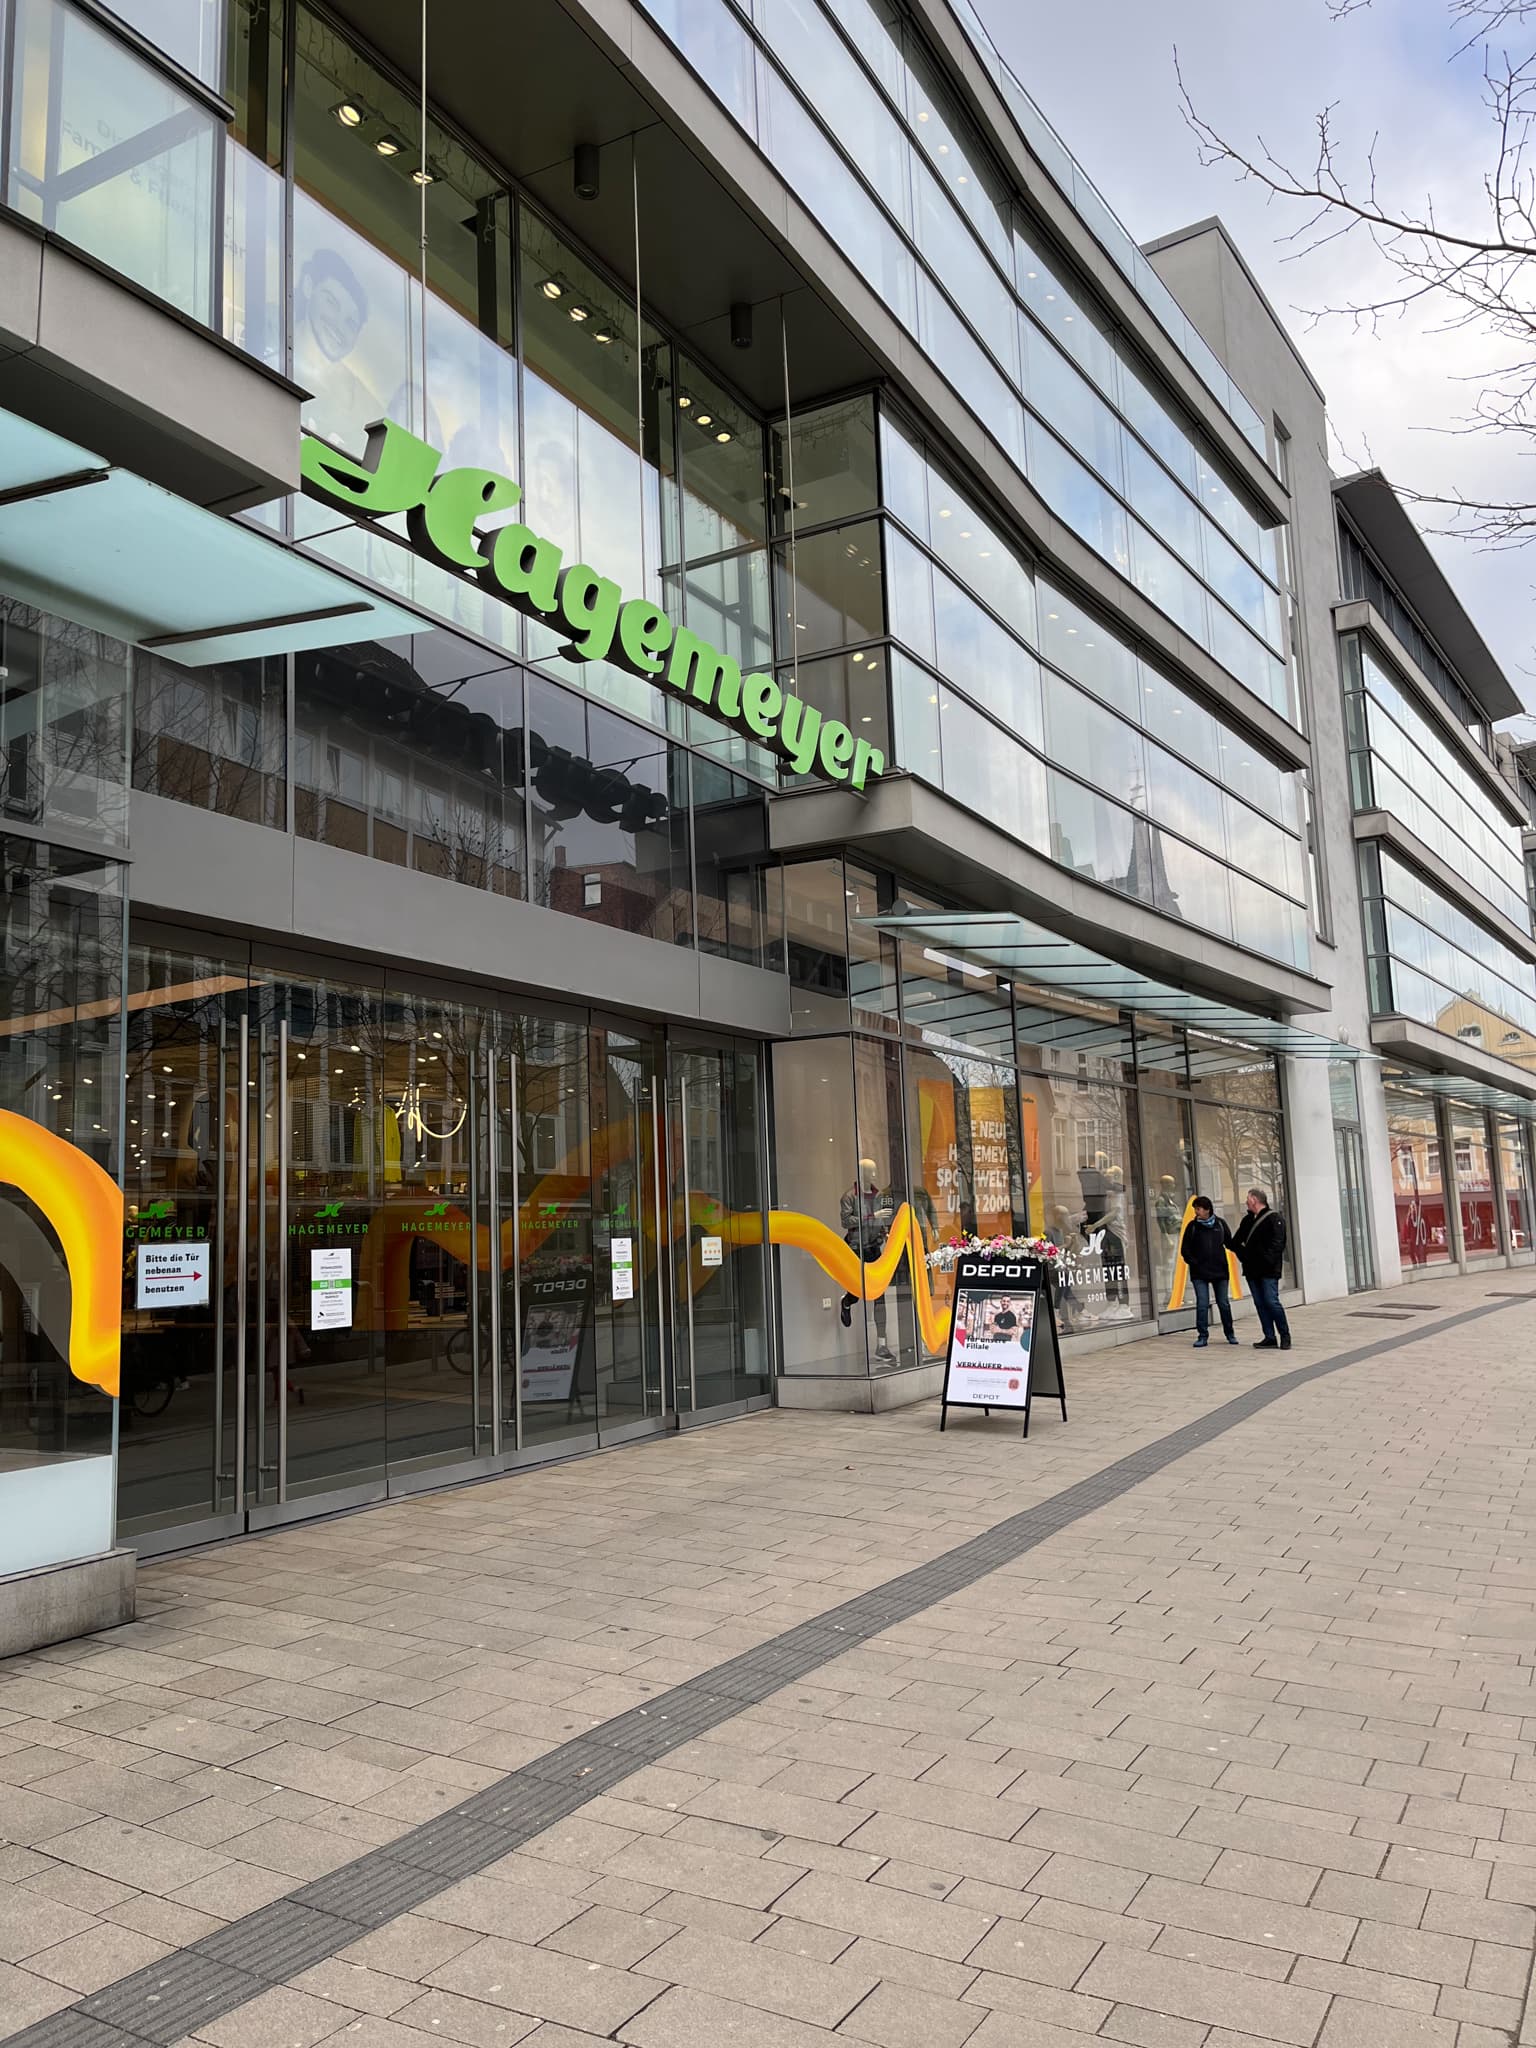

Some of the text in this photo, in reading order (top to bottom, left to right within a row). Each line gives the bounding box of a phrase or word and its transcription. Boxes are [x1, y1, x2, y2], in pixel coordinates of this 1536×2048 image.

[300, 418, 885, 793] Hagemeyer
[288, 1223, 369, 1235] HAGEMEYER
[521, 1220, 579, 1230] HAGEMEYER
[145, 1253, 200, 1263] Bitte die Tür
[145, 1266, 182, 1275] nebenan
[962, 1264, 1036, 1278] DEPOT
[1058, 1265, 1131, 1288] HAGEMEYER
[145, 1285, 185, 1294] benutzen
[1087, 1292, 1107, 1303] SPORT
[966, 1342, 990, 1350] Filiale
[956, 1360, 1003, 1370] VERKÄUFER
